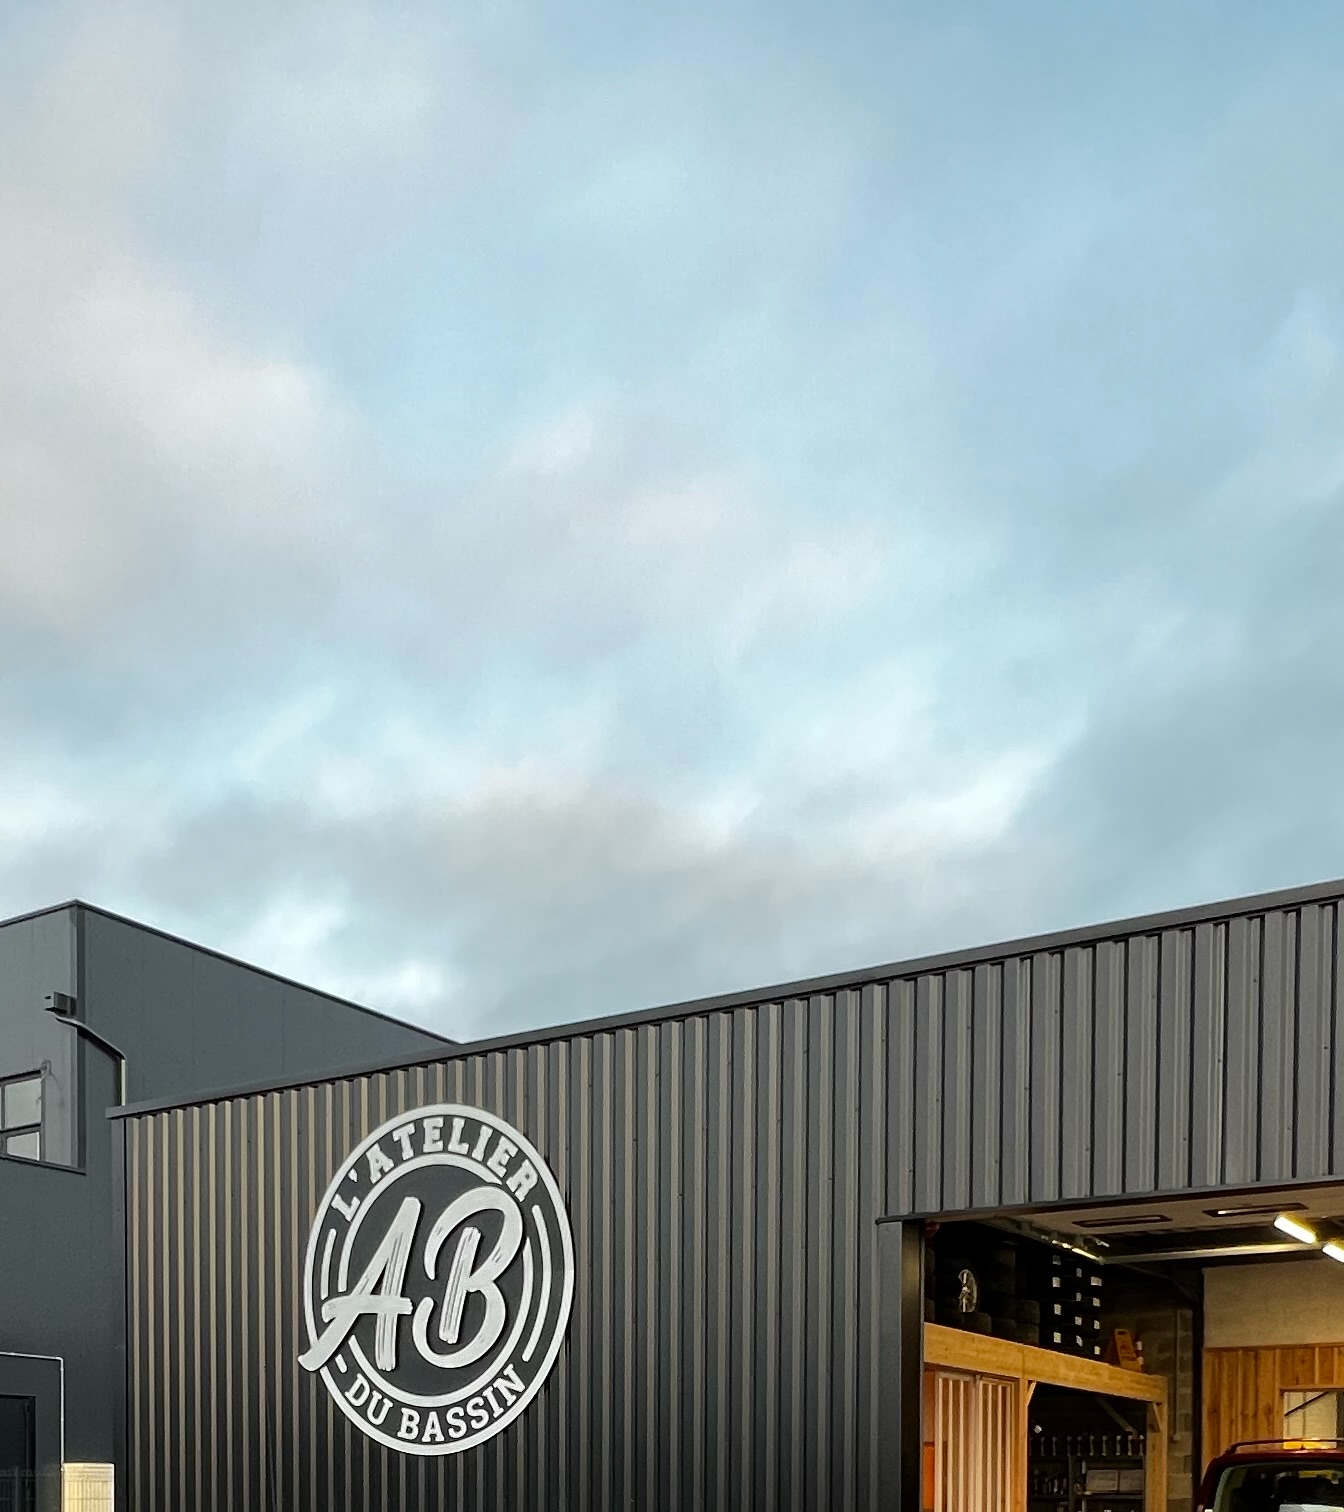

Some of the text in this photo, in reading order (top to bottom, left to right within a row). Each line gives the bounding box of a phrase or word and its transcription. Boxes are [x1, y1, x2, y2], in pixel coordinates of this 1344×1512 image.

[330, 1116, 539, 1222] L'ATELIER
[297, 1185, 524, 1372] AB
[344, 1363, 526, 1443] DU BASSIN
